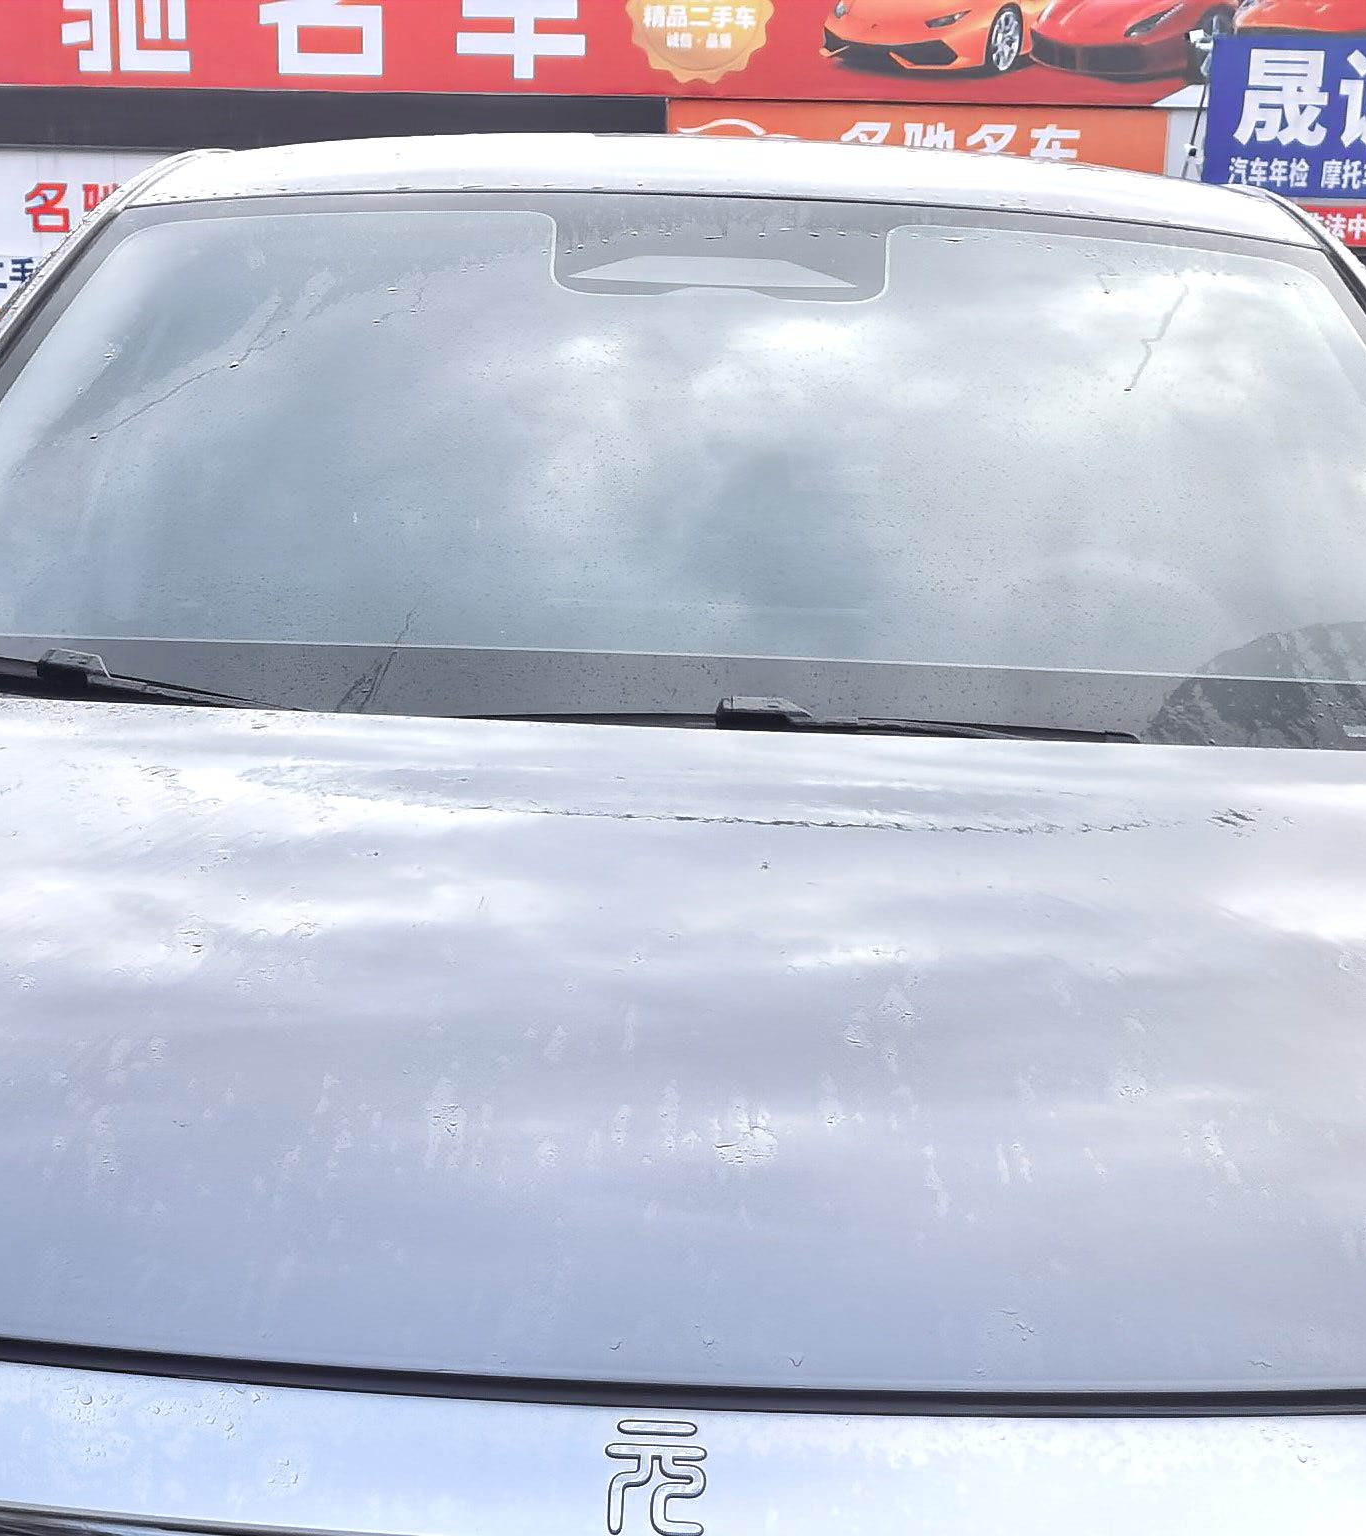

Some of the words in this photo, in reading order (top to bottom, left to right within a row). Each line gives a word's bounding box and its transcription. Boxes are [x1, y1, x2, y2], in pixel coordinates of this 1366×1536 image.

[643, 4, 757, 30] 精品二手车
[1227, 156, 1310, 188] 汽车年检
